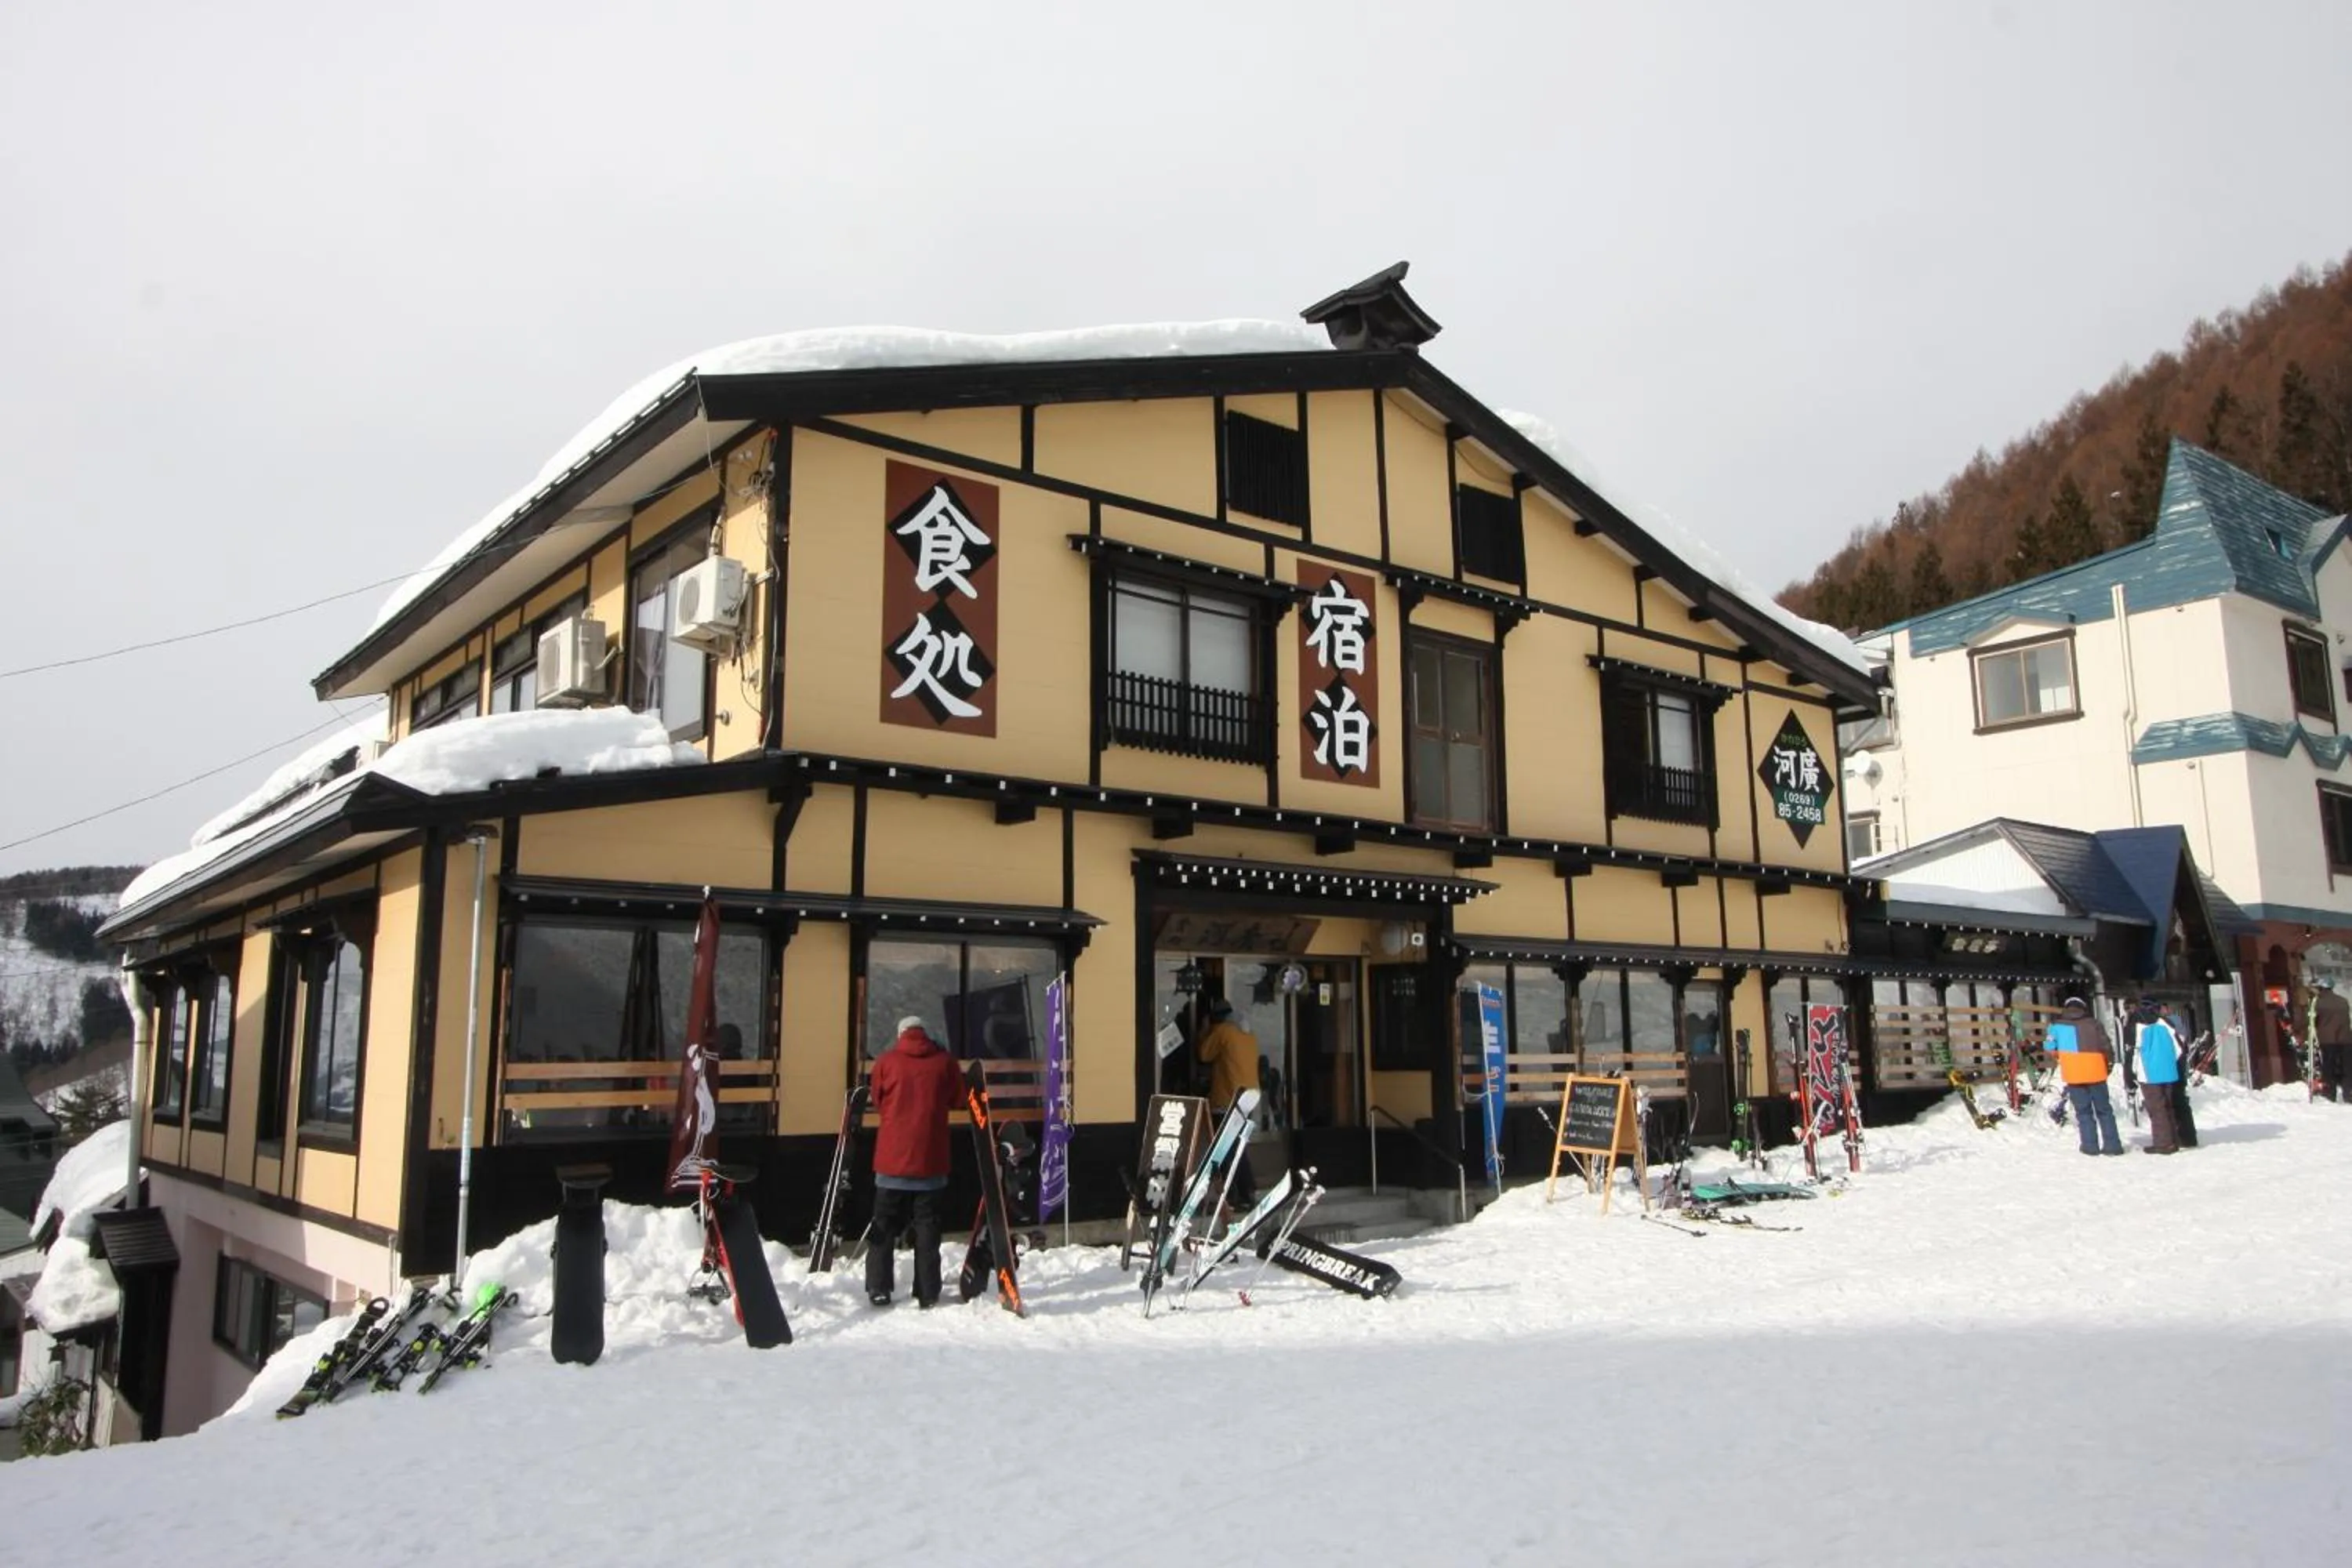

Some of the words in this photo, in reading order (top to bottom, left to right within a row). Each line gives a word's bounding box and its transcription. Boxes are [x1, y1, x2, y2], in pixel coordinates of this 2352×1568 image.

[891, 485, 992, 717] 食処
[1305, 579, 1370, 773] 宿泊
[1773, 745, 1820, 793] 河廣
[1778, 802, 1821, 822] 85-2458
